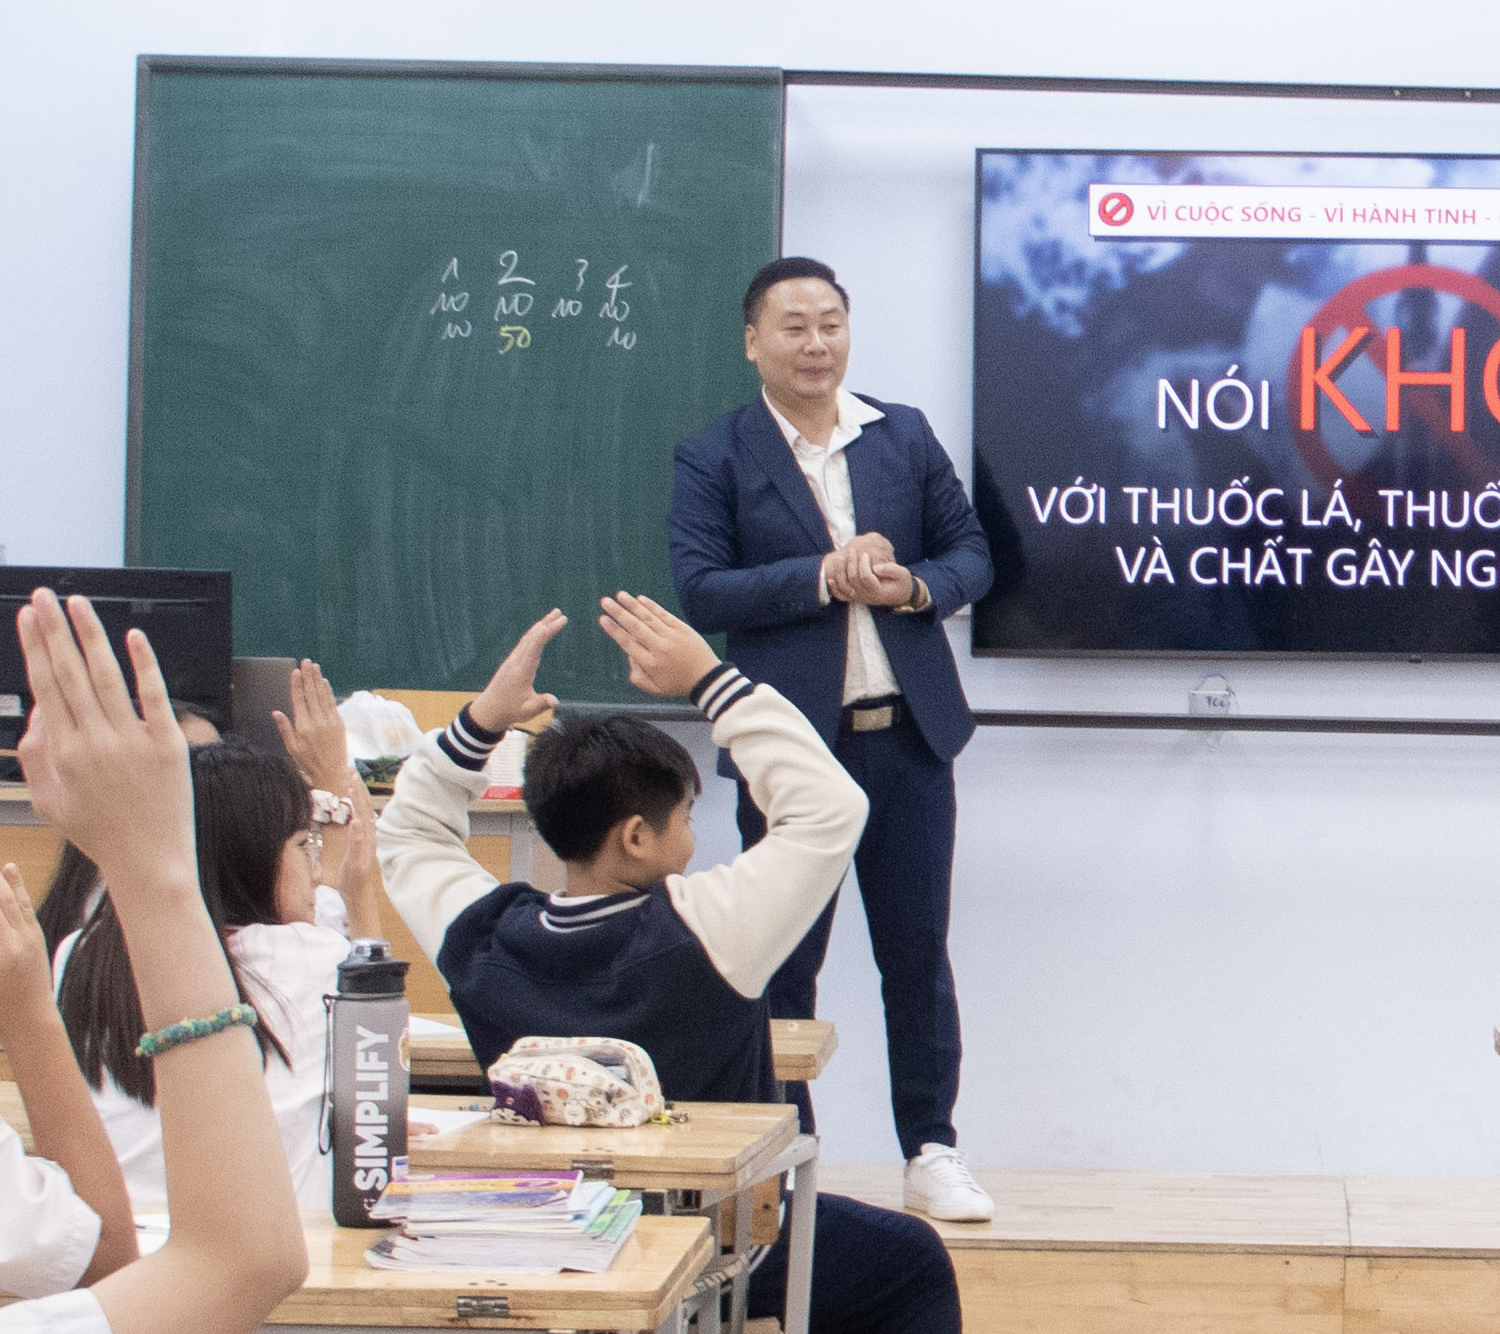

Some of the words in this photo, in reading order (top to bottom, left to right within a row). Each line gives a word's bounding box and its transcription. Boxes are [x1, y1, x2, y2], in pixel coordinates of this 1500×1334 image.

[1147, 200, 1167, 221] VÌ
[1175, 201, 1234, 227] CUỘC
[1241, 199, 1301, 223] SỐNG
[1324, 202, 1344, 223] VÌ
[1353, 202, 1416, 224] HÀNH
[1424, 208, 1477, 224] TINH
[497, 250, 536, 286] 2
[575, 258, 589, 292] 3
[498, 324, 532, 355] 50
[1157, 364, 1269, 431] NÓI
[1027, 475, 1106, 525] VỚI
[1122, 475, 1285, 527] THUỐC
[1301, 479, 1362, 533] LÁ,
[1115, 535, 1175, 585] VÀ
[1189, 535, 1313, 586] CHẤT
[1326, 537, 1415, 587] GÂY
[354, 1024, 390, 1192] SIMPLIFY
